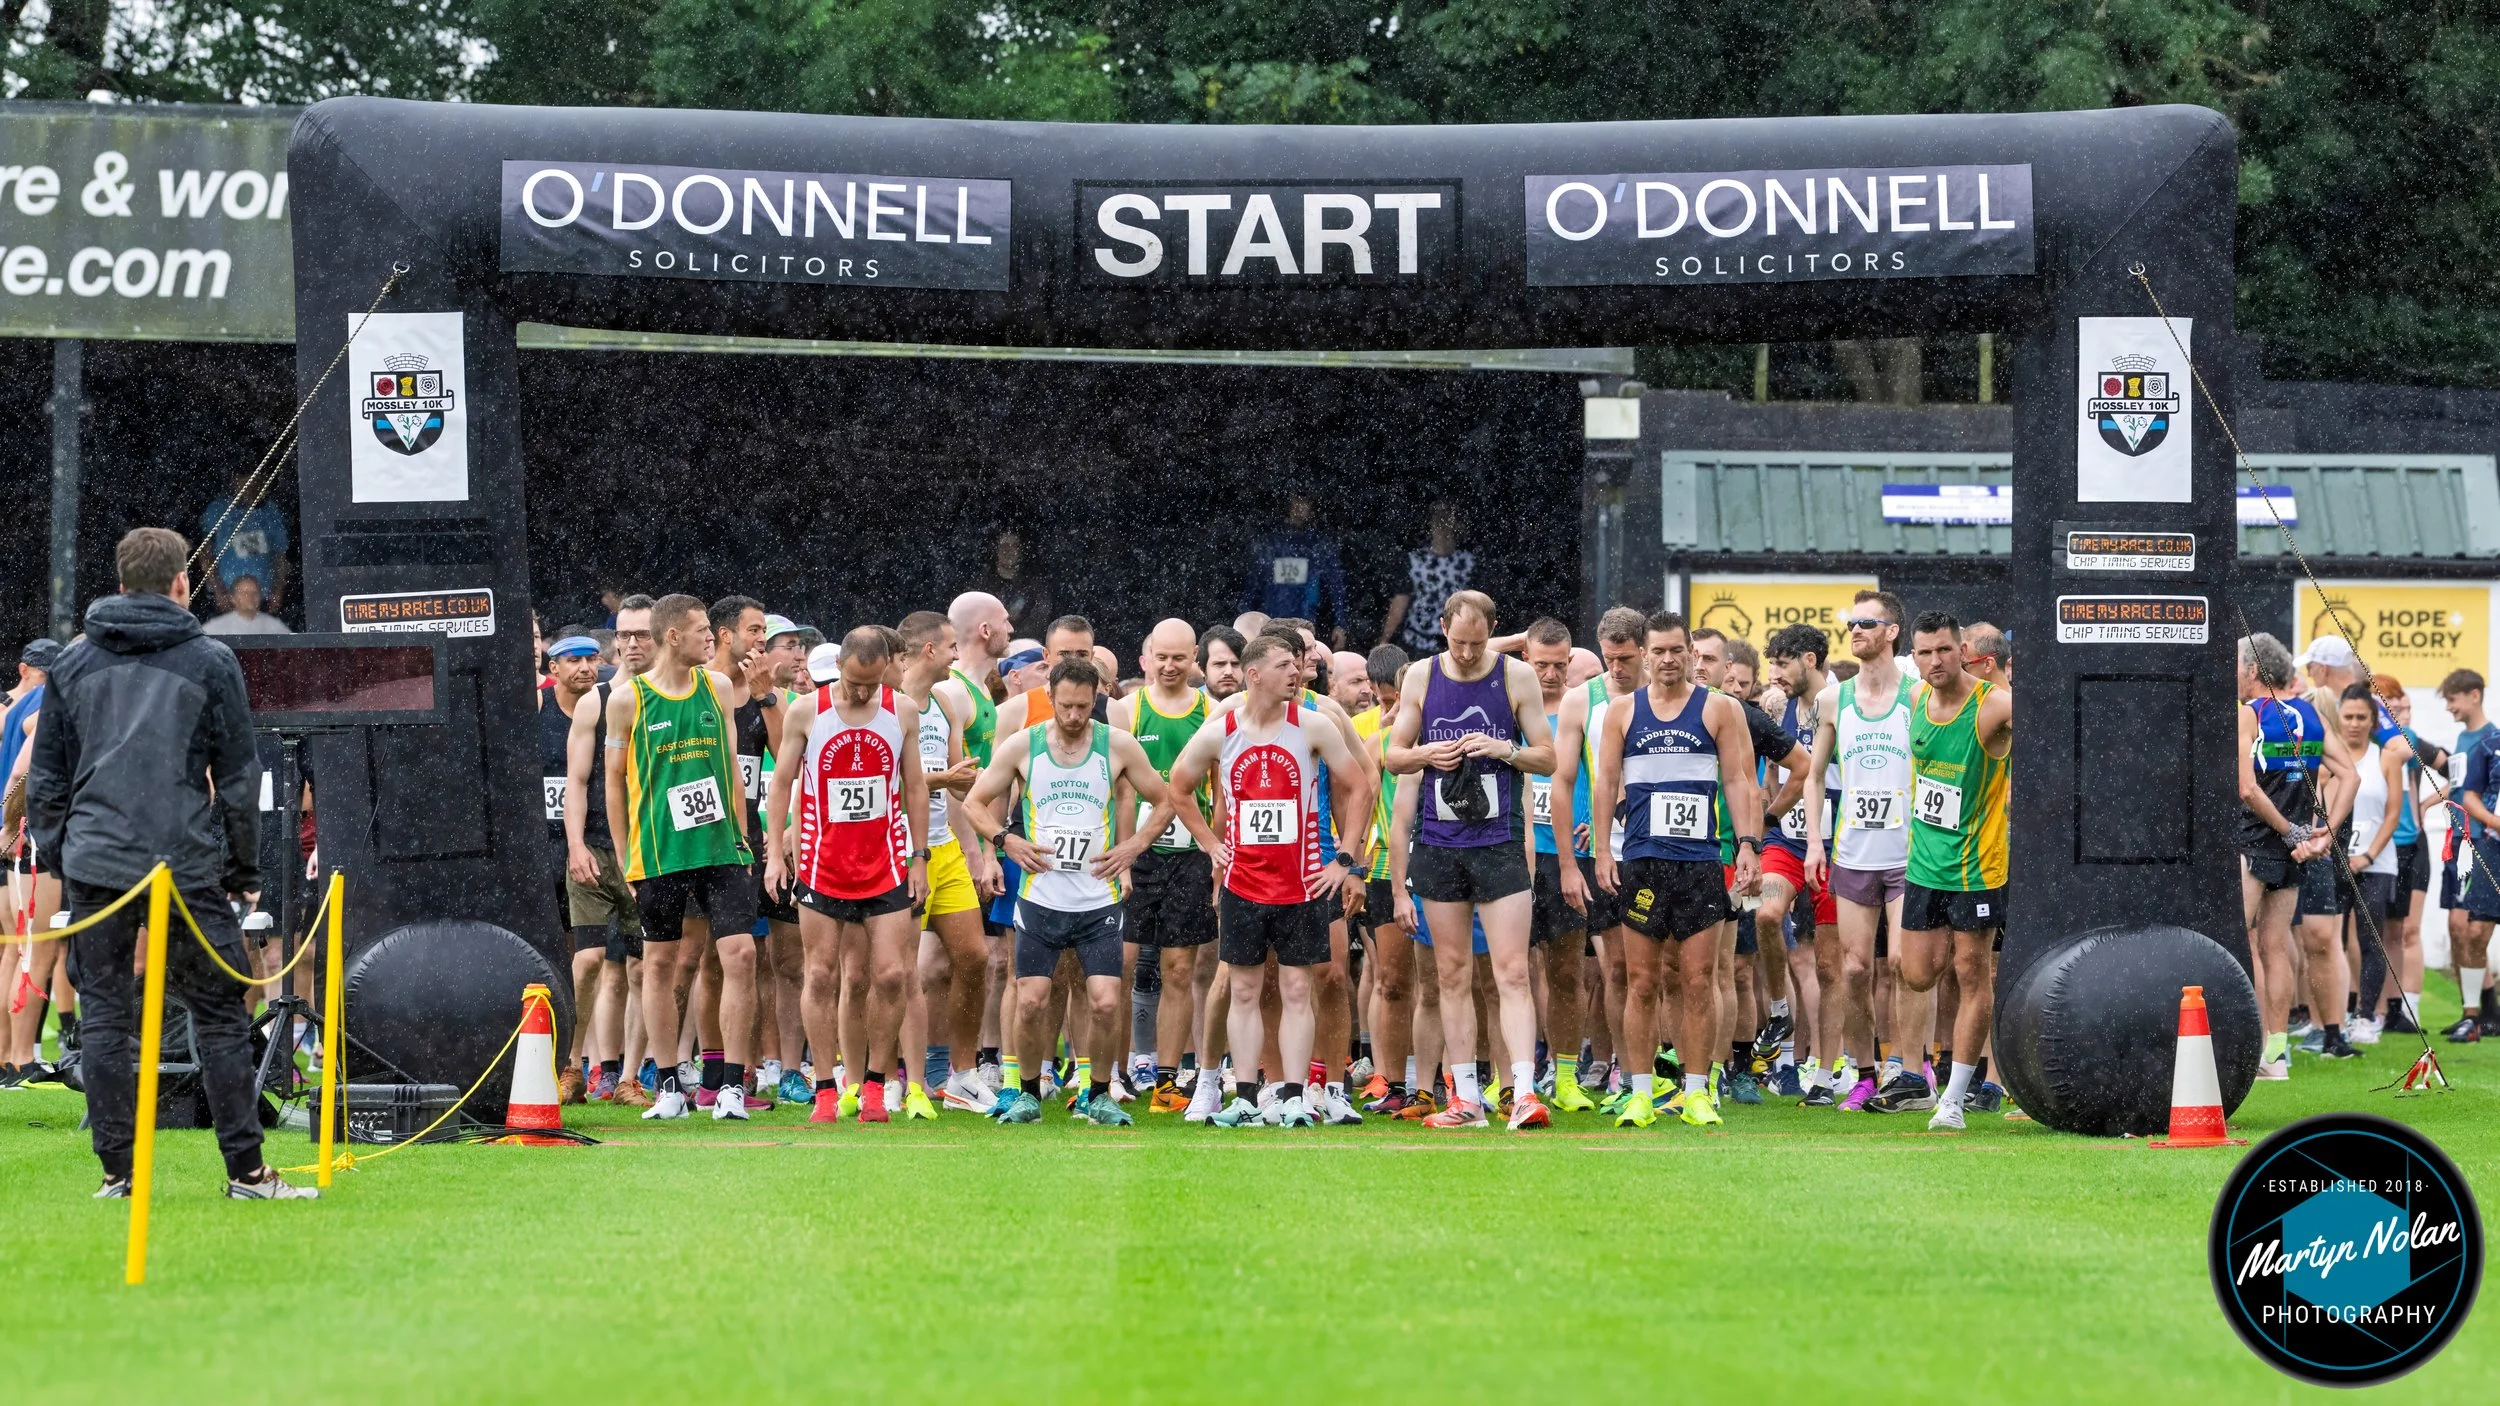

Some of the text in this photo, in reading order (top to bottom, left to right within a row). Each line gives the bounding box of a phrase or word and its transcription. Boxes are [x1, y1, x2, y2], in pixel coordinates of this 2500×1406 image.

[81, 150, 135, 217] &
[522, 168, 992, 245] O'DONNELL
[1546, 173, 2016, 241] O'DONNELL
[1094, 193, 1441, 278] START
[629, 249, 879, 279] SOLICITORS
[1656, 250, 1906, 277] SOLICITORS
[367, 399, 443, 410] MOSSLEY 10K
[2092, 401, 2169, 410] MOSSLEY 10K
[2073, 556, 2191, 568] CHIP TIMING SERVICES
[1765, 607, 1833, 623] HOPE
[2378, 611, 2446, 627] HOPE
[2065, 626, 2203, 640] CHIP TIMING SERVICES
[2378, 631, 2462, 648] GLORY
[648, 720, 672, 732] ICON
[656, 737, 717, 754] EAST CHESHIRE
[1636, 729, 1702, 748] SADDLEWORTH
[1855, 733, 1892, 742] ROYTON
[669, 750, 710, 763] HARRIERS
[822, 732, 890, 771] OLDHAM & ROYTON
[1648, 746, 1690, 754] RUNNERS
[1866, 744, 1907, 760] RUNNERS
[851, 762, 863, 771] AC
[1234, 751, 1299, 791] OLDHAM & ROYTON
[677, 783, 703, 794] MOSSLEY
[1050, 780, 1090, 790] ROYTON
[1260, 778, 1271, 788] AC
[1922, 779, 1942, 790] MOSSLEY
[681, 787, 716, 817] 384
[840, 786, 873, 811] 251
[1036, 791, 1104, 810] ROAD RUNNERS
[1661, 794, 1689, 802] MOSSLEY
[1924, 789, 1944, 815] 49
[1665, 802, 1698, 827] 134
[1856, 797, 1892, 820] 397
[1249, 809, 1282, 833] 421
[1054, 837, 1091, 861] 217
